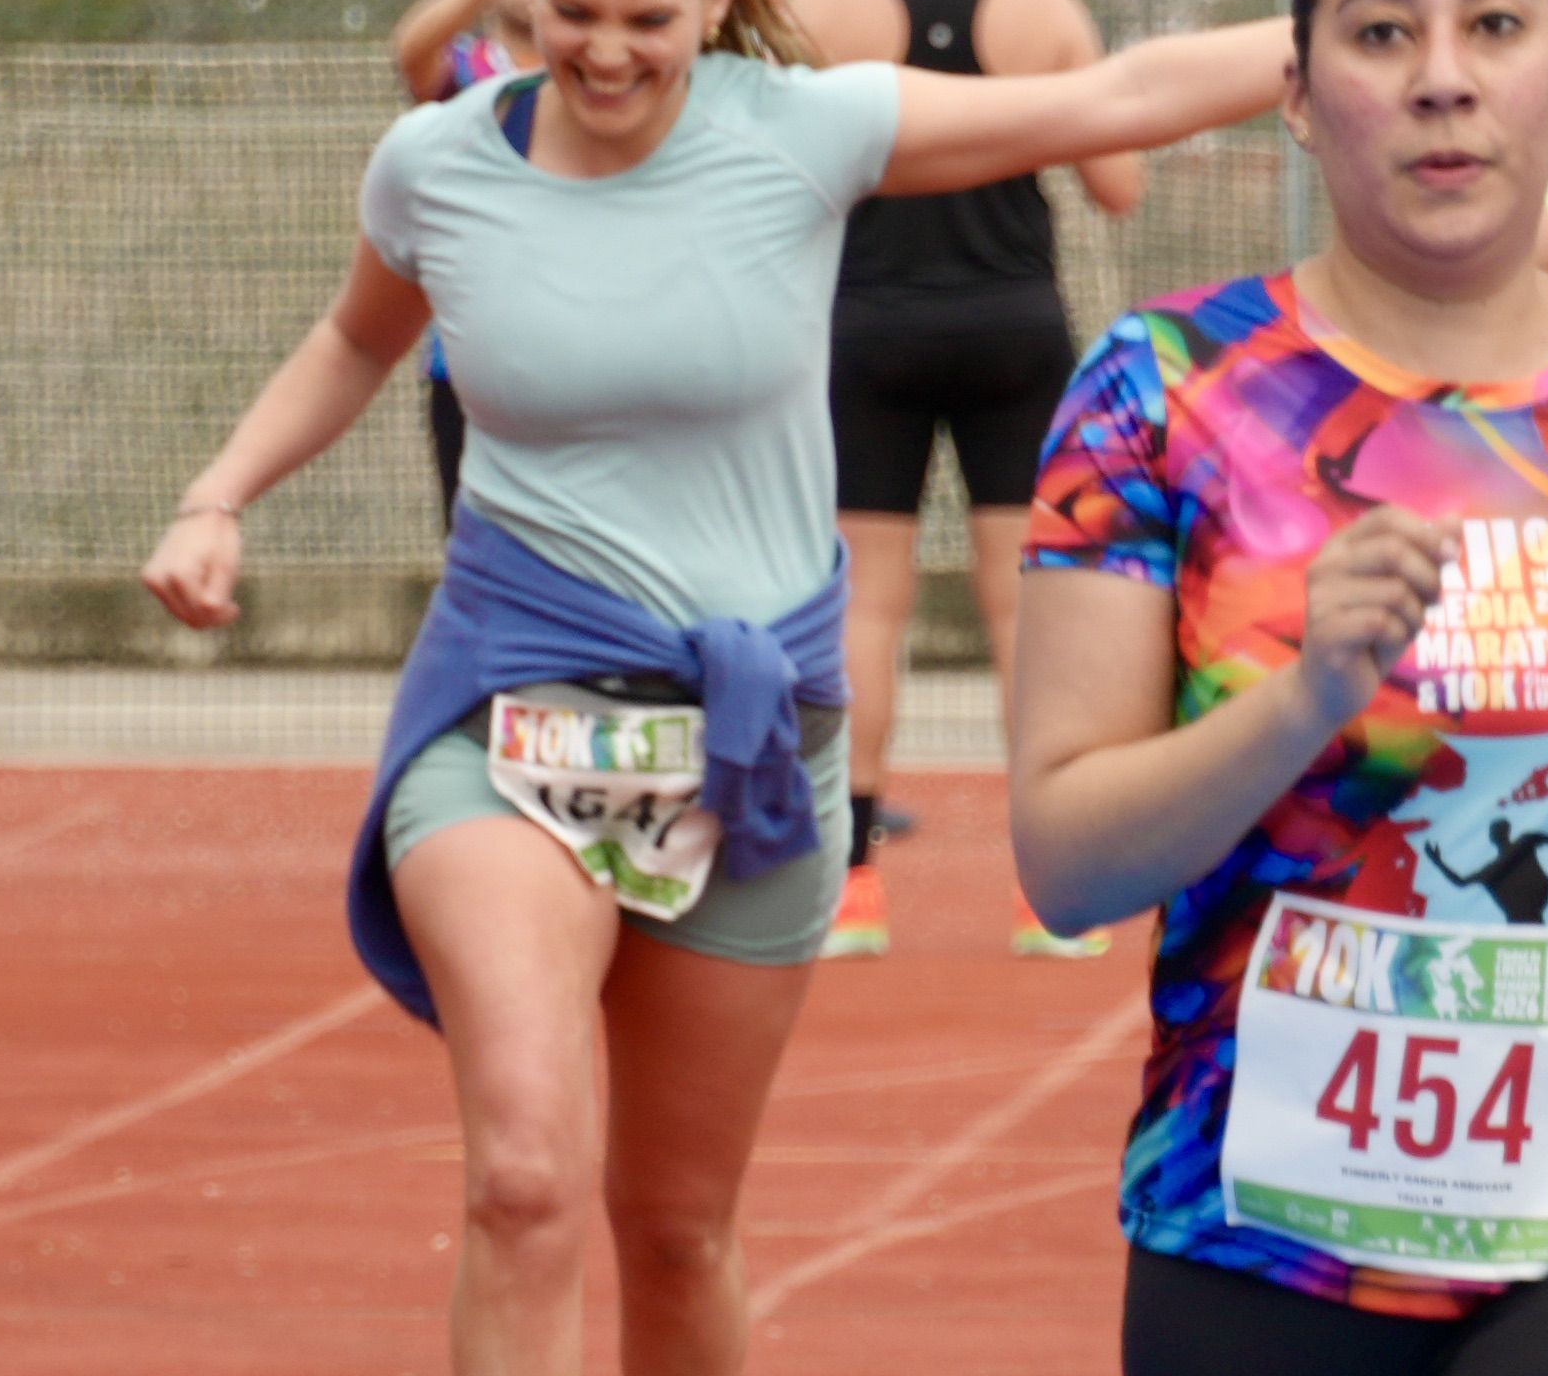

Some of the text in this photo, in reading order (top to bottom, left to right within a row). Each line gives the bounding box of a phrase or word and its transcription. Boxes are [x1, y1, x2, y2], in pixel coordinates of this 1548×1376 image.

[1443, 671, 1518, 713] 10K
[1290, 919, 1401, 1013] 10K
[1492, 994, 1540, 1020] 2026
[1315, 1028, 1535, 1165] 454
